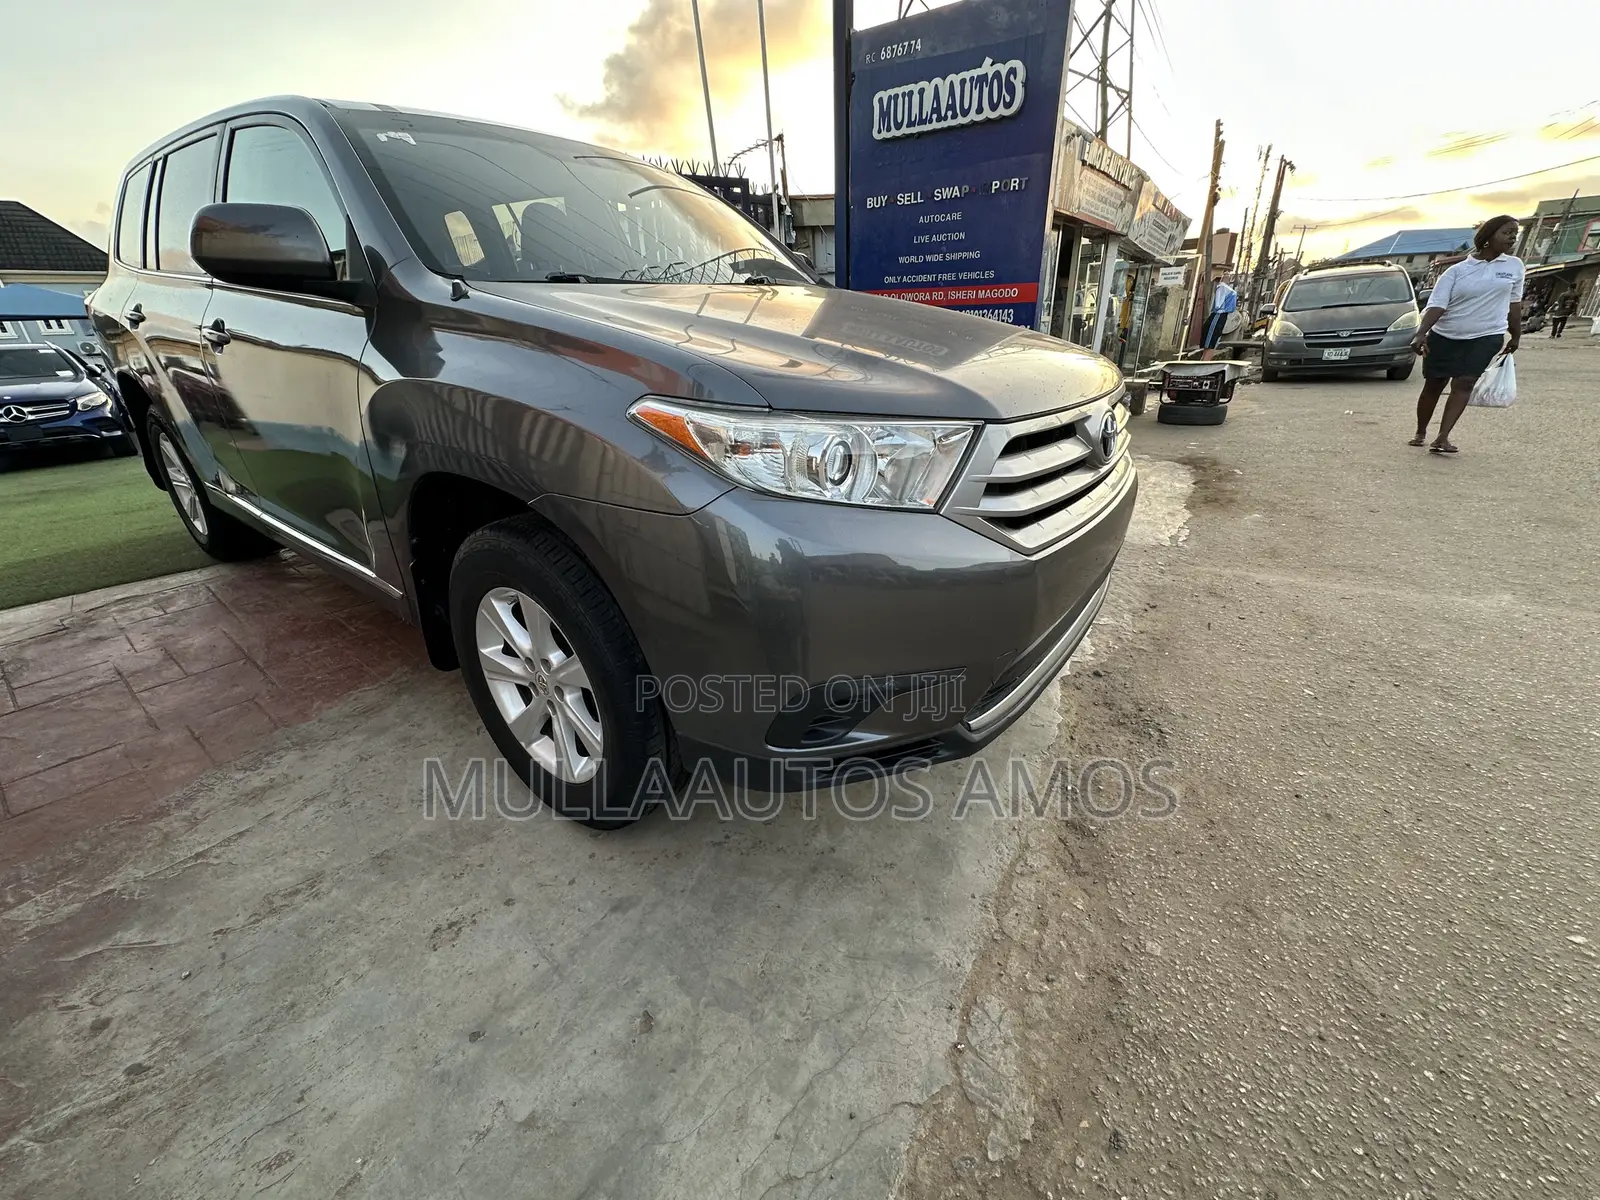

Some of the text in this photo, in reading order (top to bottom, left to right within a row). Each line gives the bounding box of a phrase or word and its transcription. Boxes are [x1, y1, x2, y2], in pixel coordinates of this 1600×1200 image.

[865, 38, 922, 64] RC 6876774
[877, 66, 1018, 135] MULLAAUTOS
[866, 195, 888, 209] BUY
[896, 191, 924, 206] SELL
[934, 184, 970, 201] SWAP
[918, 211, 963, 224] AUTOCARE
[913, 231, 966, 244] LIVE AUCTION
[898, 250, 981, 264] WORLD WIDE SHIPPING
[884, 270, 995, 284] ONLY ACCIDENT FREE VEHICLES
[948, 289, 976, 300] ISHERI
[978, 287, 1018, 298] MAGODO
